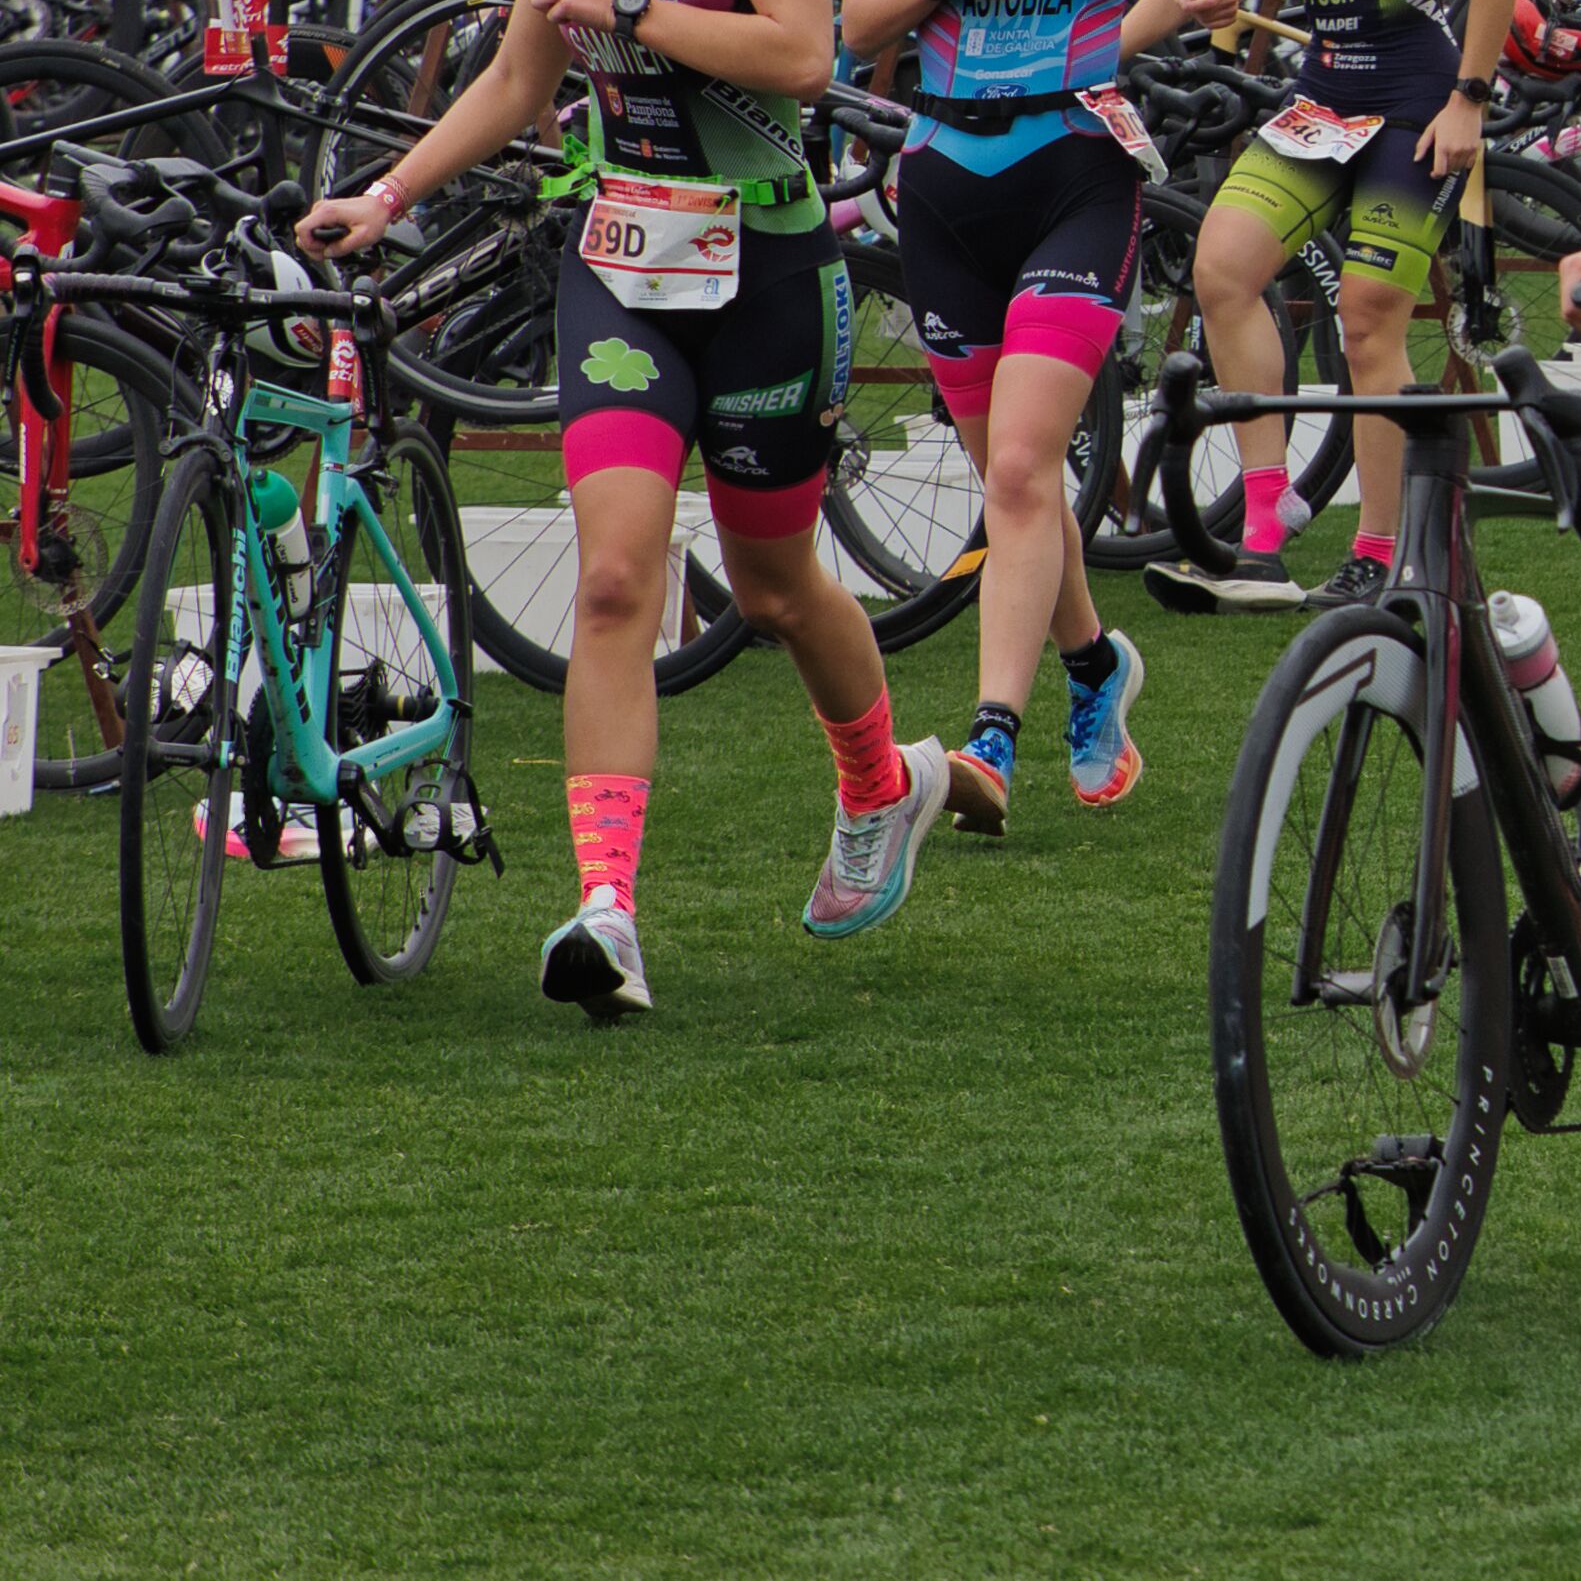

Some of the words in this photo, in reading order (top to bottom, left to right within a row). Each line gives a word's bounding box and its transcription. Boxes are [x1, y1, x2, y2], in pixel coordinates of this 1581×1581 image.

[1315, 16, 1358, 32] MAPEI
[626, 104, 677, 119] Pamplona
[585, 219, 647, 259] 59D
[711, 381, 804, 412] FINISHER
[225, 527, 248, 684] Bianchi
[1426, 1064, 1496, 1283] PRINCETON
